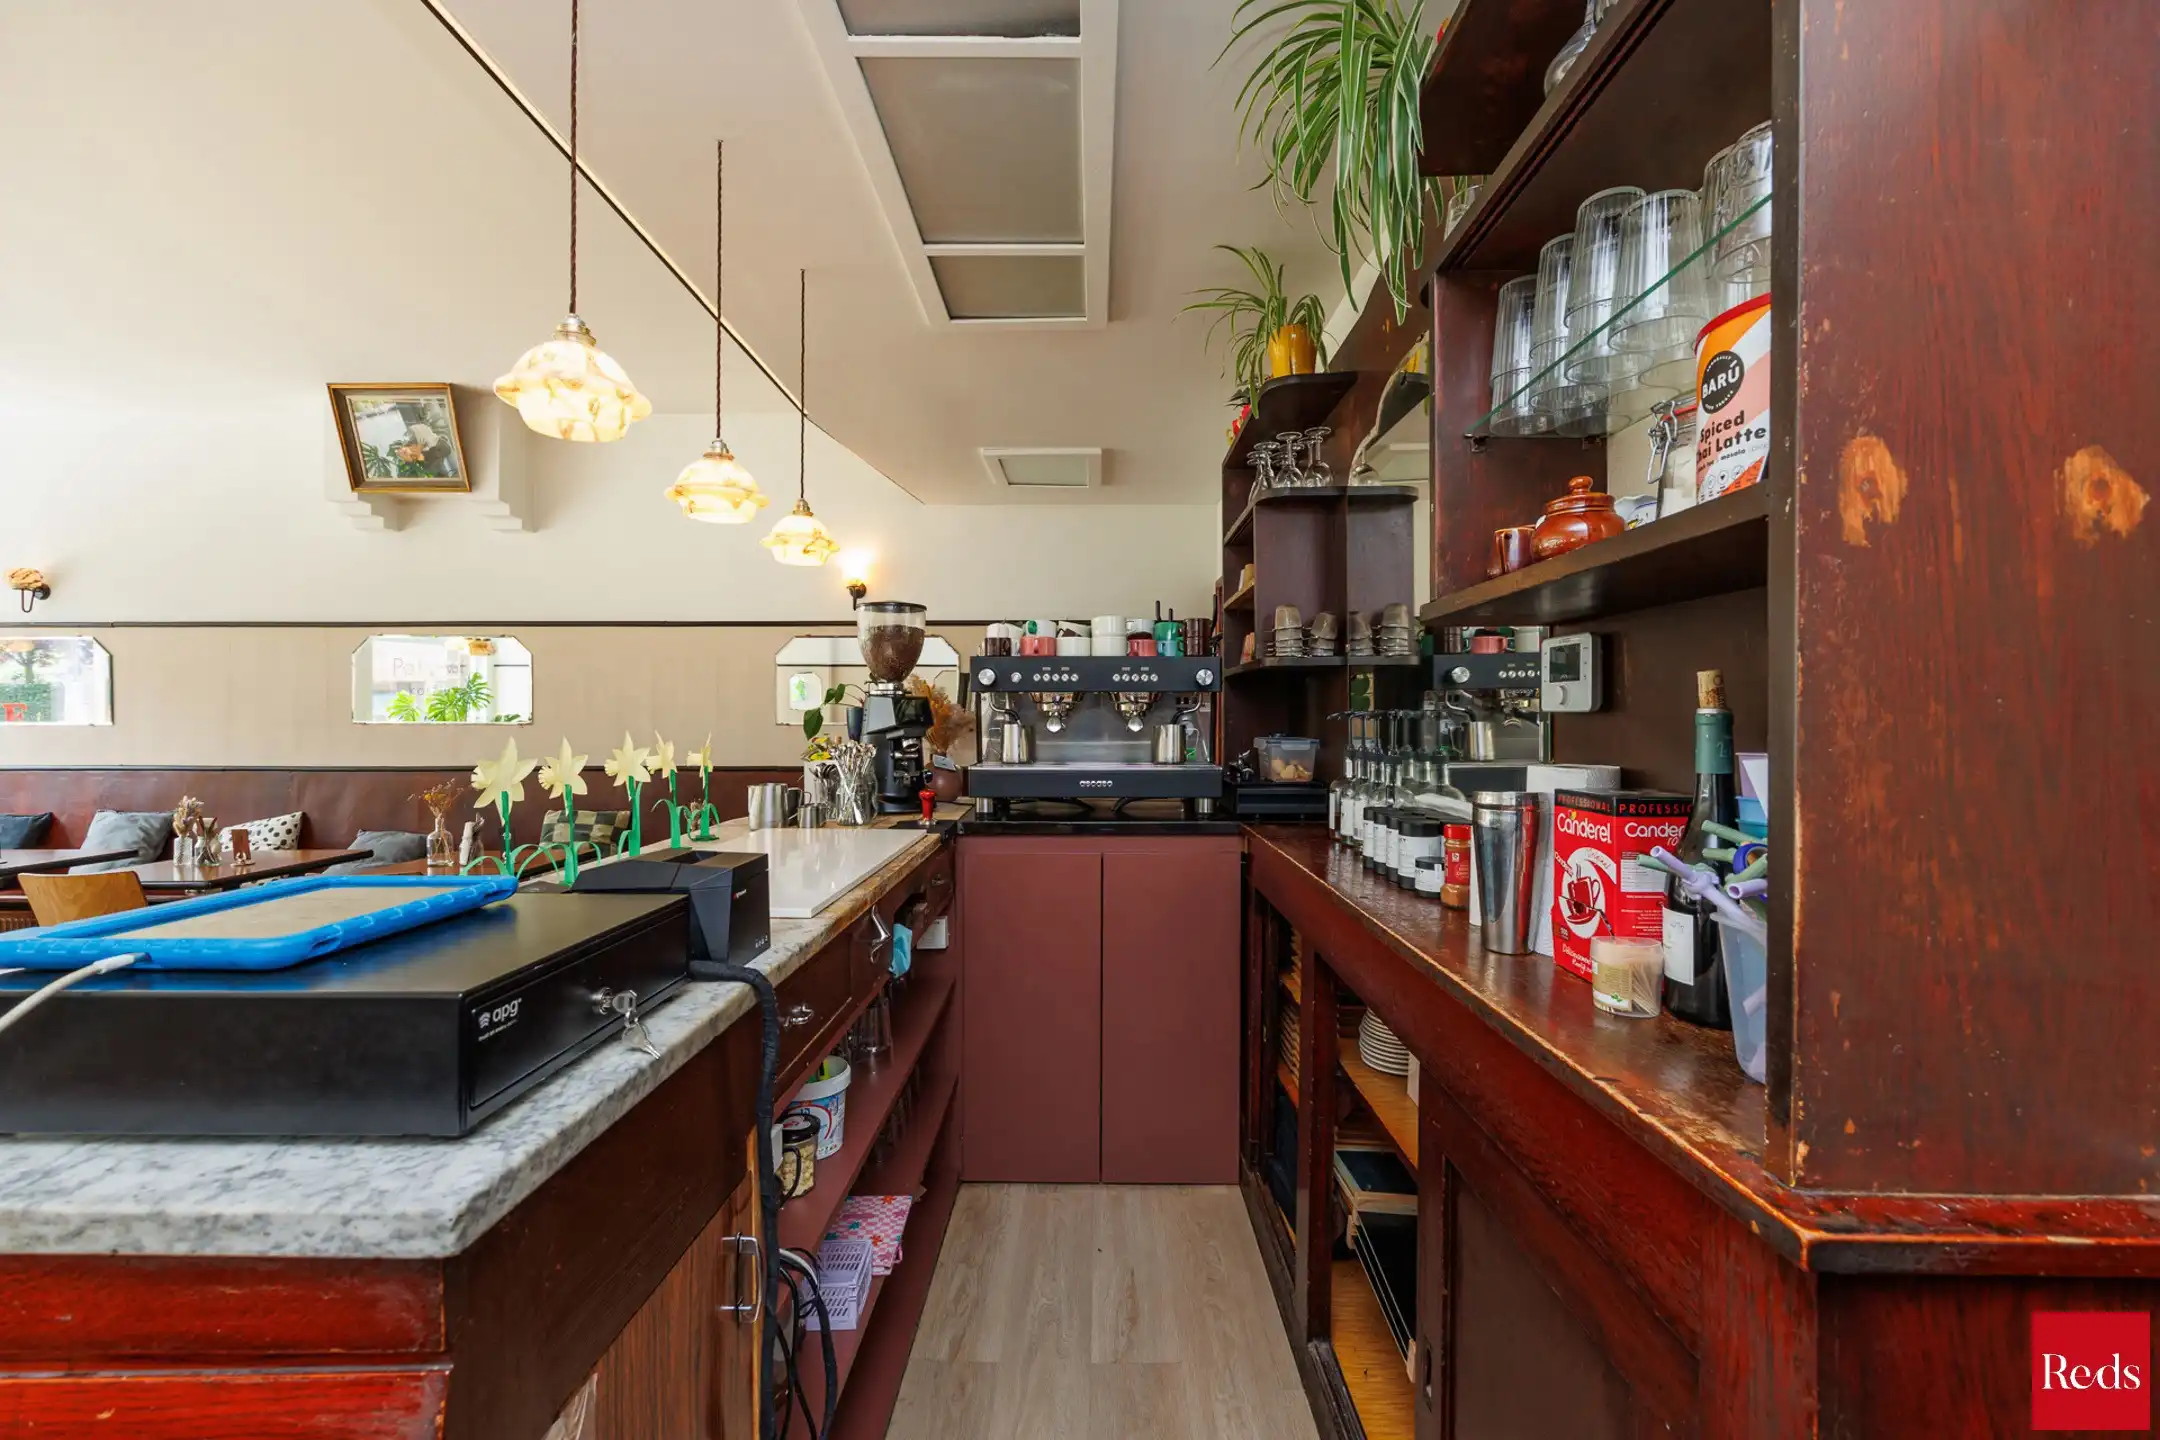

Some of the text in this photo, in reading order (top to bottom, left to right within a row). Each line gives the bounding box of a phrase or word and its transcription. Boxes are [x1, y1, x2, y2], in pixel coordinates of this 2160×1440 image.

[1702, 359, 1740, 399] BARÚ
[1700, 410, 1745, 444] Spiced
[1716, 427, 1767, 453] Latte
[1557, 794, 1612, 812] PROFESSIONAL
[1557, 812, 1612, 843] Canderel
[1624, 822, 1685, 838] Cander
[492, 999, 519, 1022] apg
